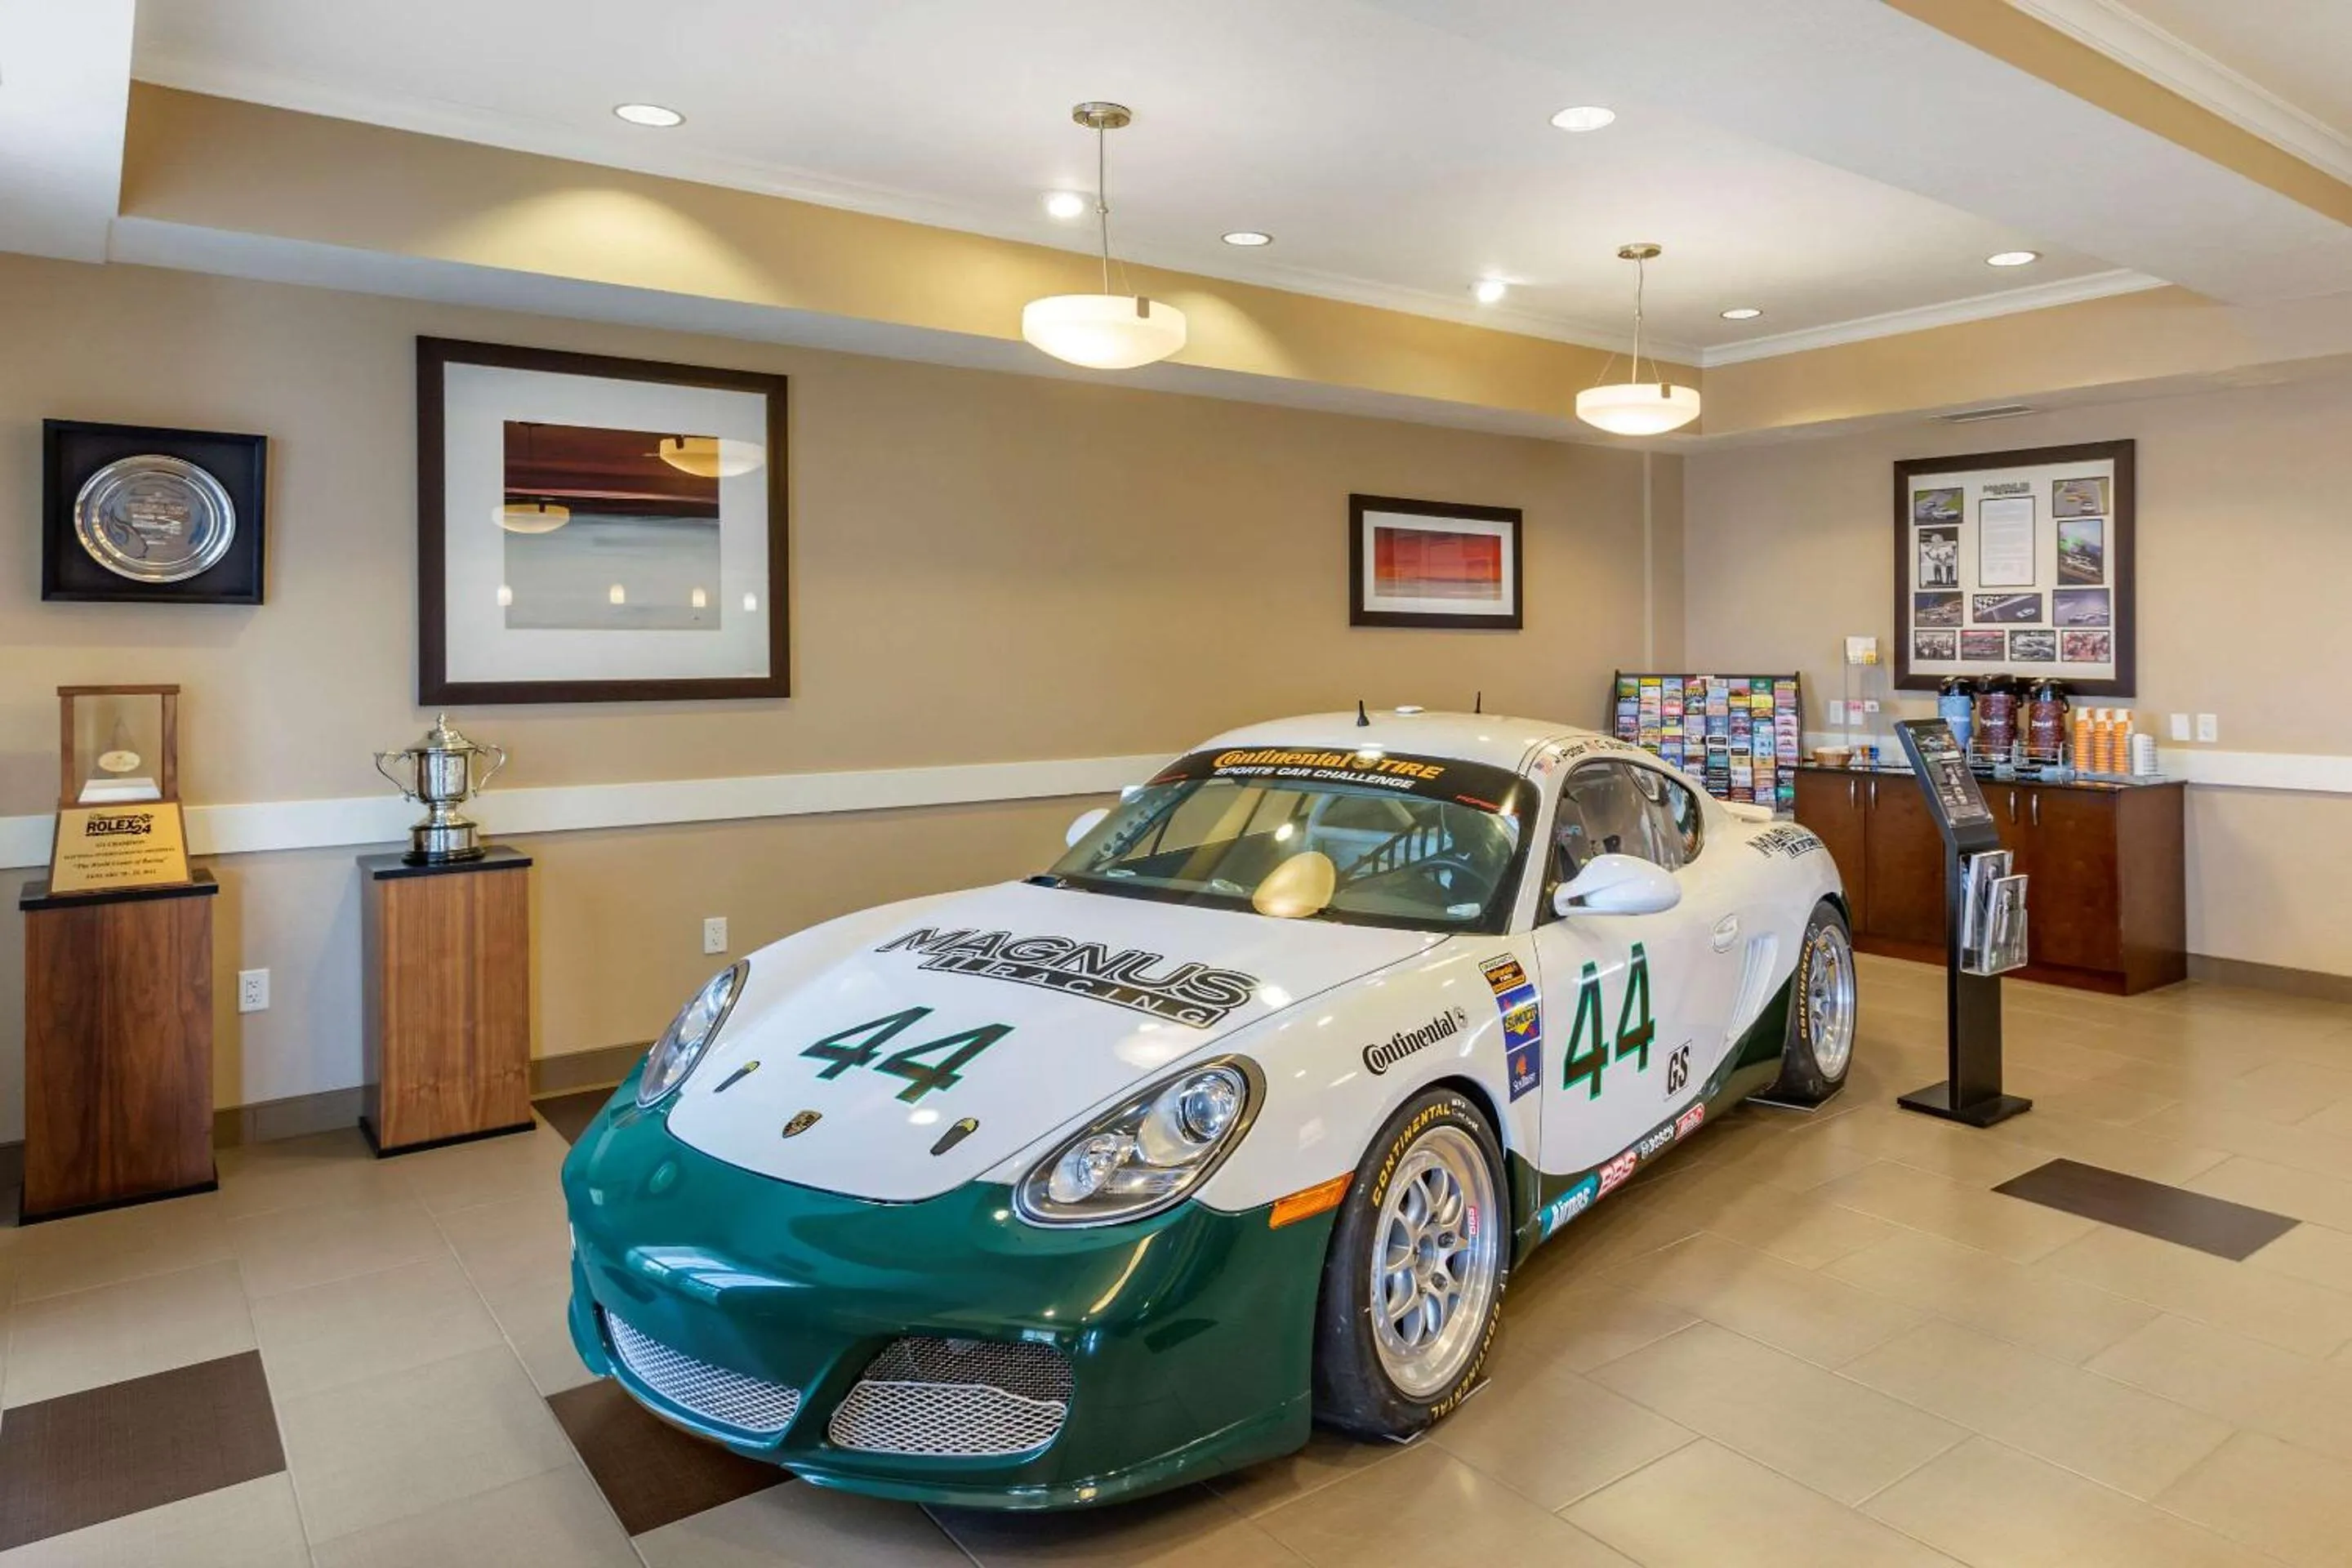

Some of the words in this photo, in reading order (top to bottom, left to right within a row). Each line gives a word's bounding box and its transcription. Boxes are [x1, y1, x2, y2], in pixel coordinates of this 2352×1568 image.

[1214, 749, 1356, 768] Continental
[1376, 759, 1446, 780] TIRE
[1214, 766, 1274, 777] SPORTS
[1278, 768, 1316, 777] CAR
[1316, 769, 1415, 790] CHALLENGE
[86, 819, 135, 833] ROLEX
[131, 823, 152, 835] 24
[875, 927, 1262, 1010] MAGNUS
[1361, 1010, 1459, 1076] Continental
[1562, 941, 1656, 1101] 44
[798, 1005, 1016, 1104] 44
[1667, 1045, 1690, 1096] GS
[1371, 1101, 1451, 1209] CONTINENTAL
[1597, 1152, 1637, 1199] BBS
[1430, 1301, 1501, 1419] CONTINENTAL
